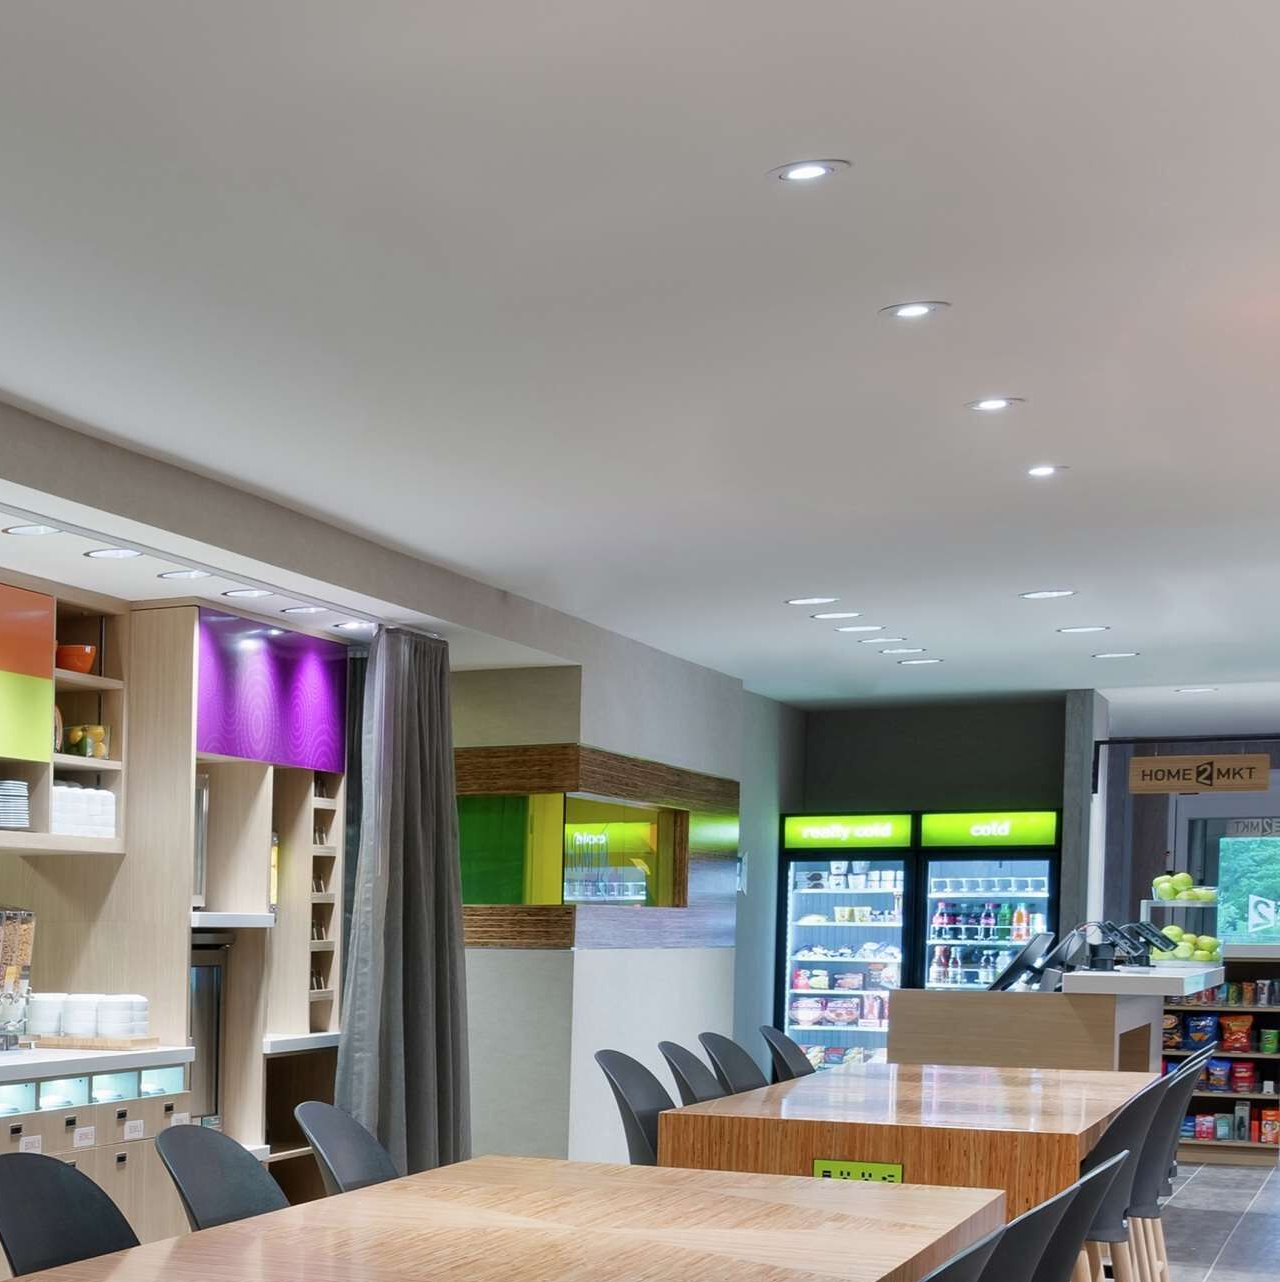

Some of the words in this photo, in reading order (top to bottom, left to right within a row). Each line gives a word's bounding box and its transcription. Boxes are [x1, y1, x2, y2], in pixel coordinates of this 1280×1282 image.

[1141, 768, 1193, 781] HOME
[1196, 761, 1214, 787] 2
[1216, 767, 1257, 780] MKT
[854, 821, 893, 838] cold
[970, 821, 1010, 837] cold
